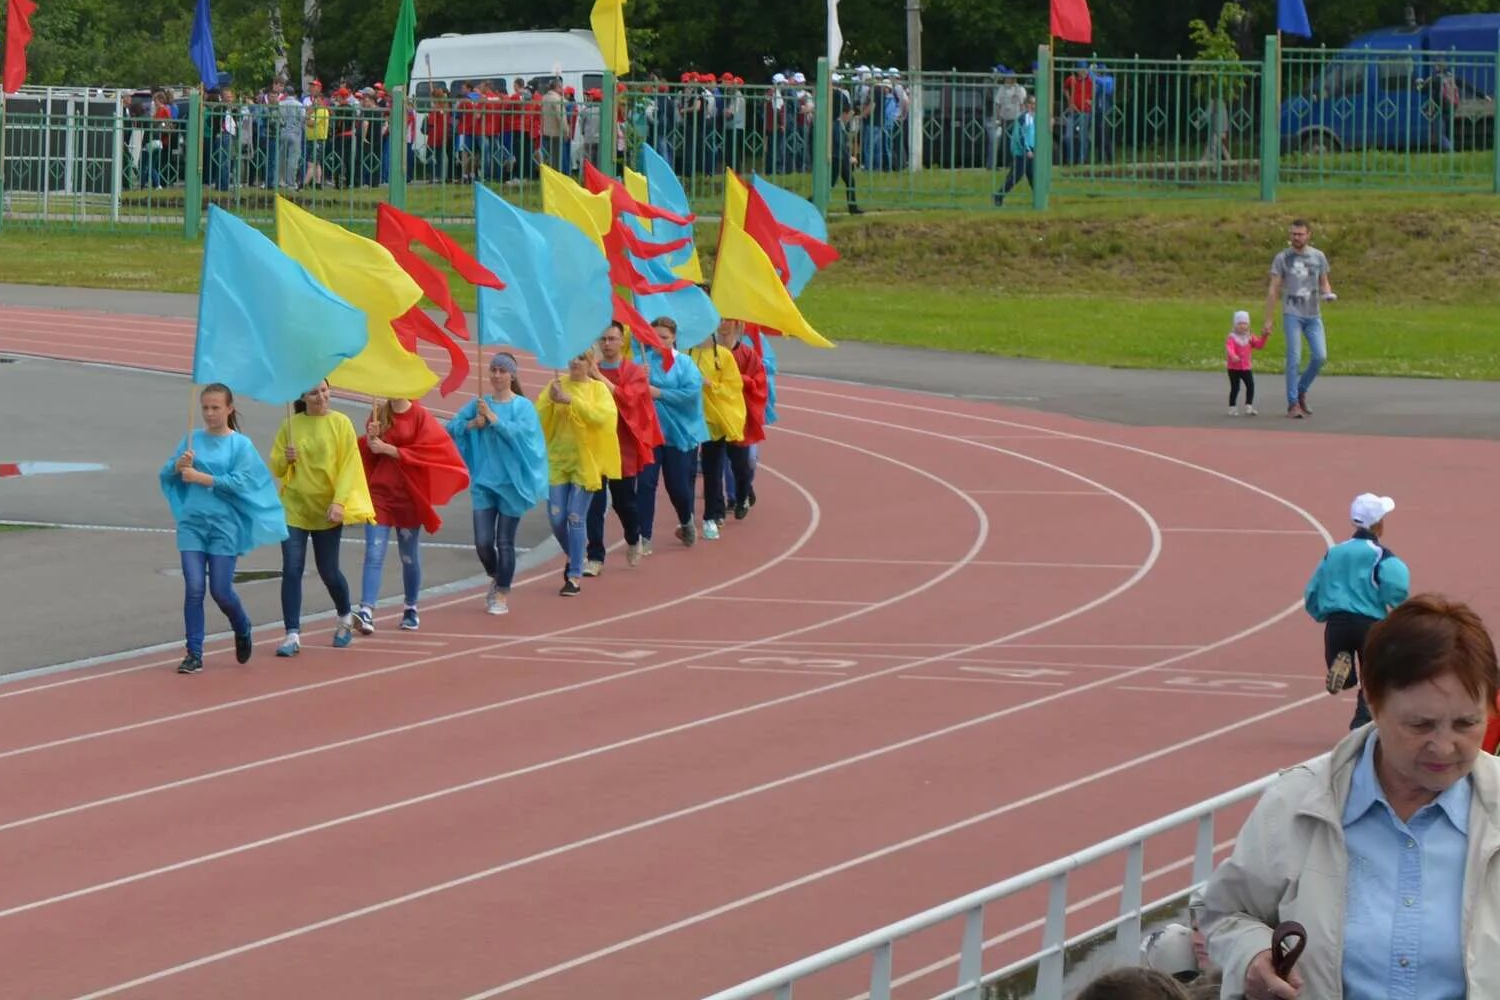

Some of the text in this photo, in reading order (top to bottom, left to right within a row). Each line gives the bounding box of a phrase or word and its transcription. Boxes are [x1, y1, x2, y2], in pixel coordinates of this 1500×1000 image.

[536, 646, 658, 659] 2
[737, 656, 858, 668] 3
[958, 665, 1076, 677] 4
[1163, 676, 1289, 689] 5
